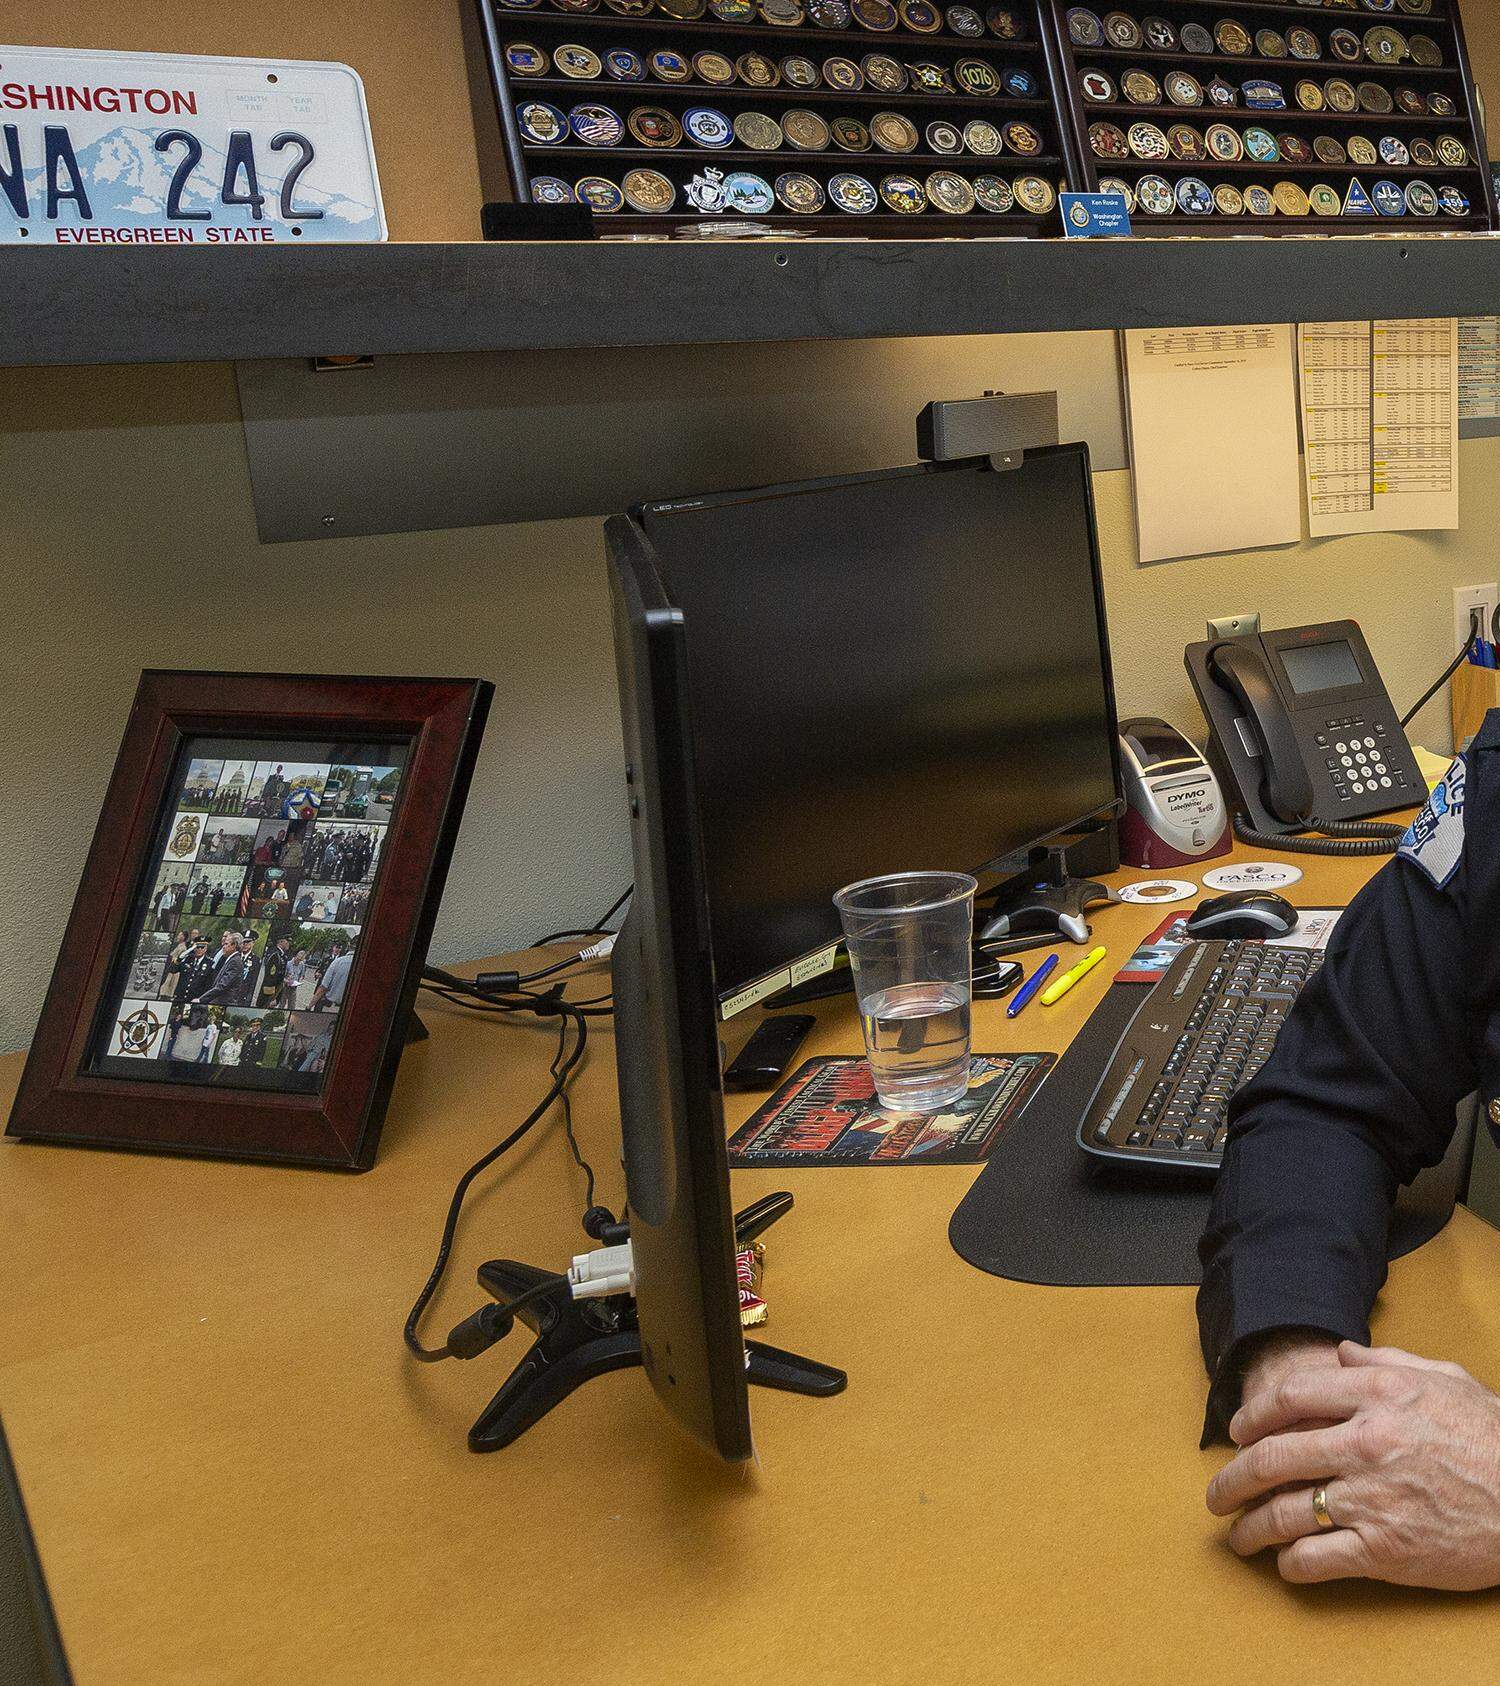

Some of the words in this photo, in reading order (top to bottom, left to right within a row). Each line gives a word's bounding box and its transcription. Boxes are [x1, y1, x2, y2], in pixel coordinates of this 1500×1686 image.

[963, 68, 992, 86] 1076
[0, 82, 198, 116] SHINGTON
[155, 128, 324, 222] 242
[56, 227, 194, 243] EVERGREEN
[206, 227, 275, 243] STATE
[1167, 789, 1206, 803] DYMO
[1219, 873, 1287, 881] PASCO
